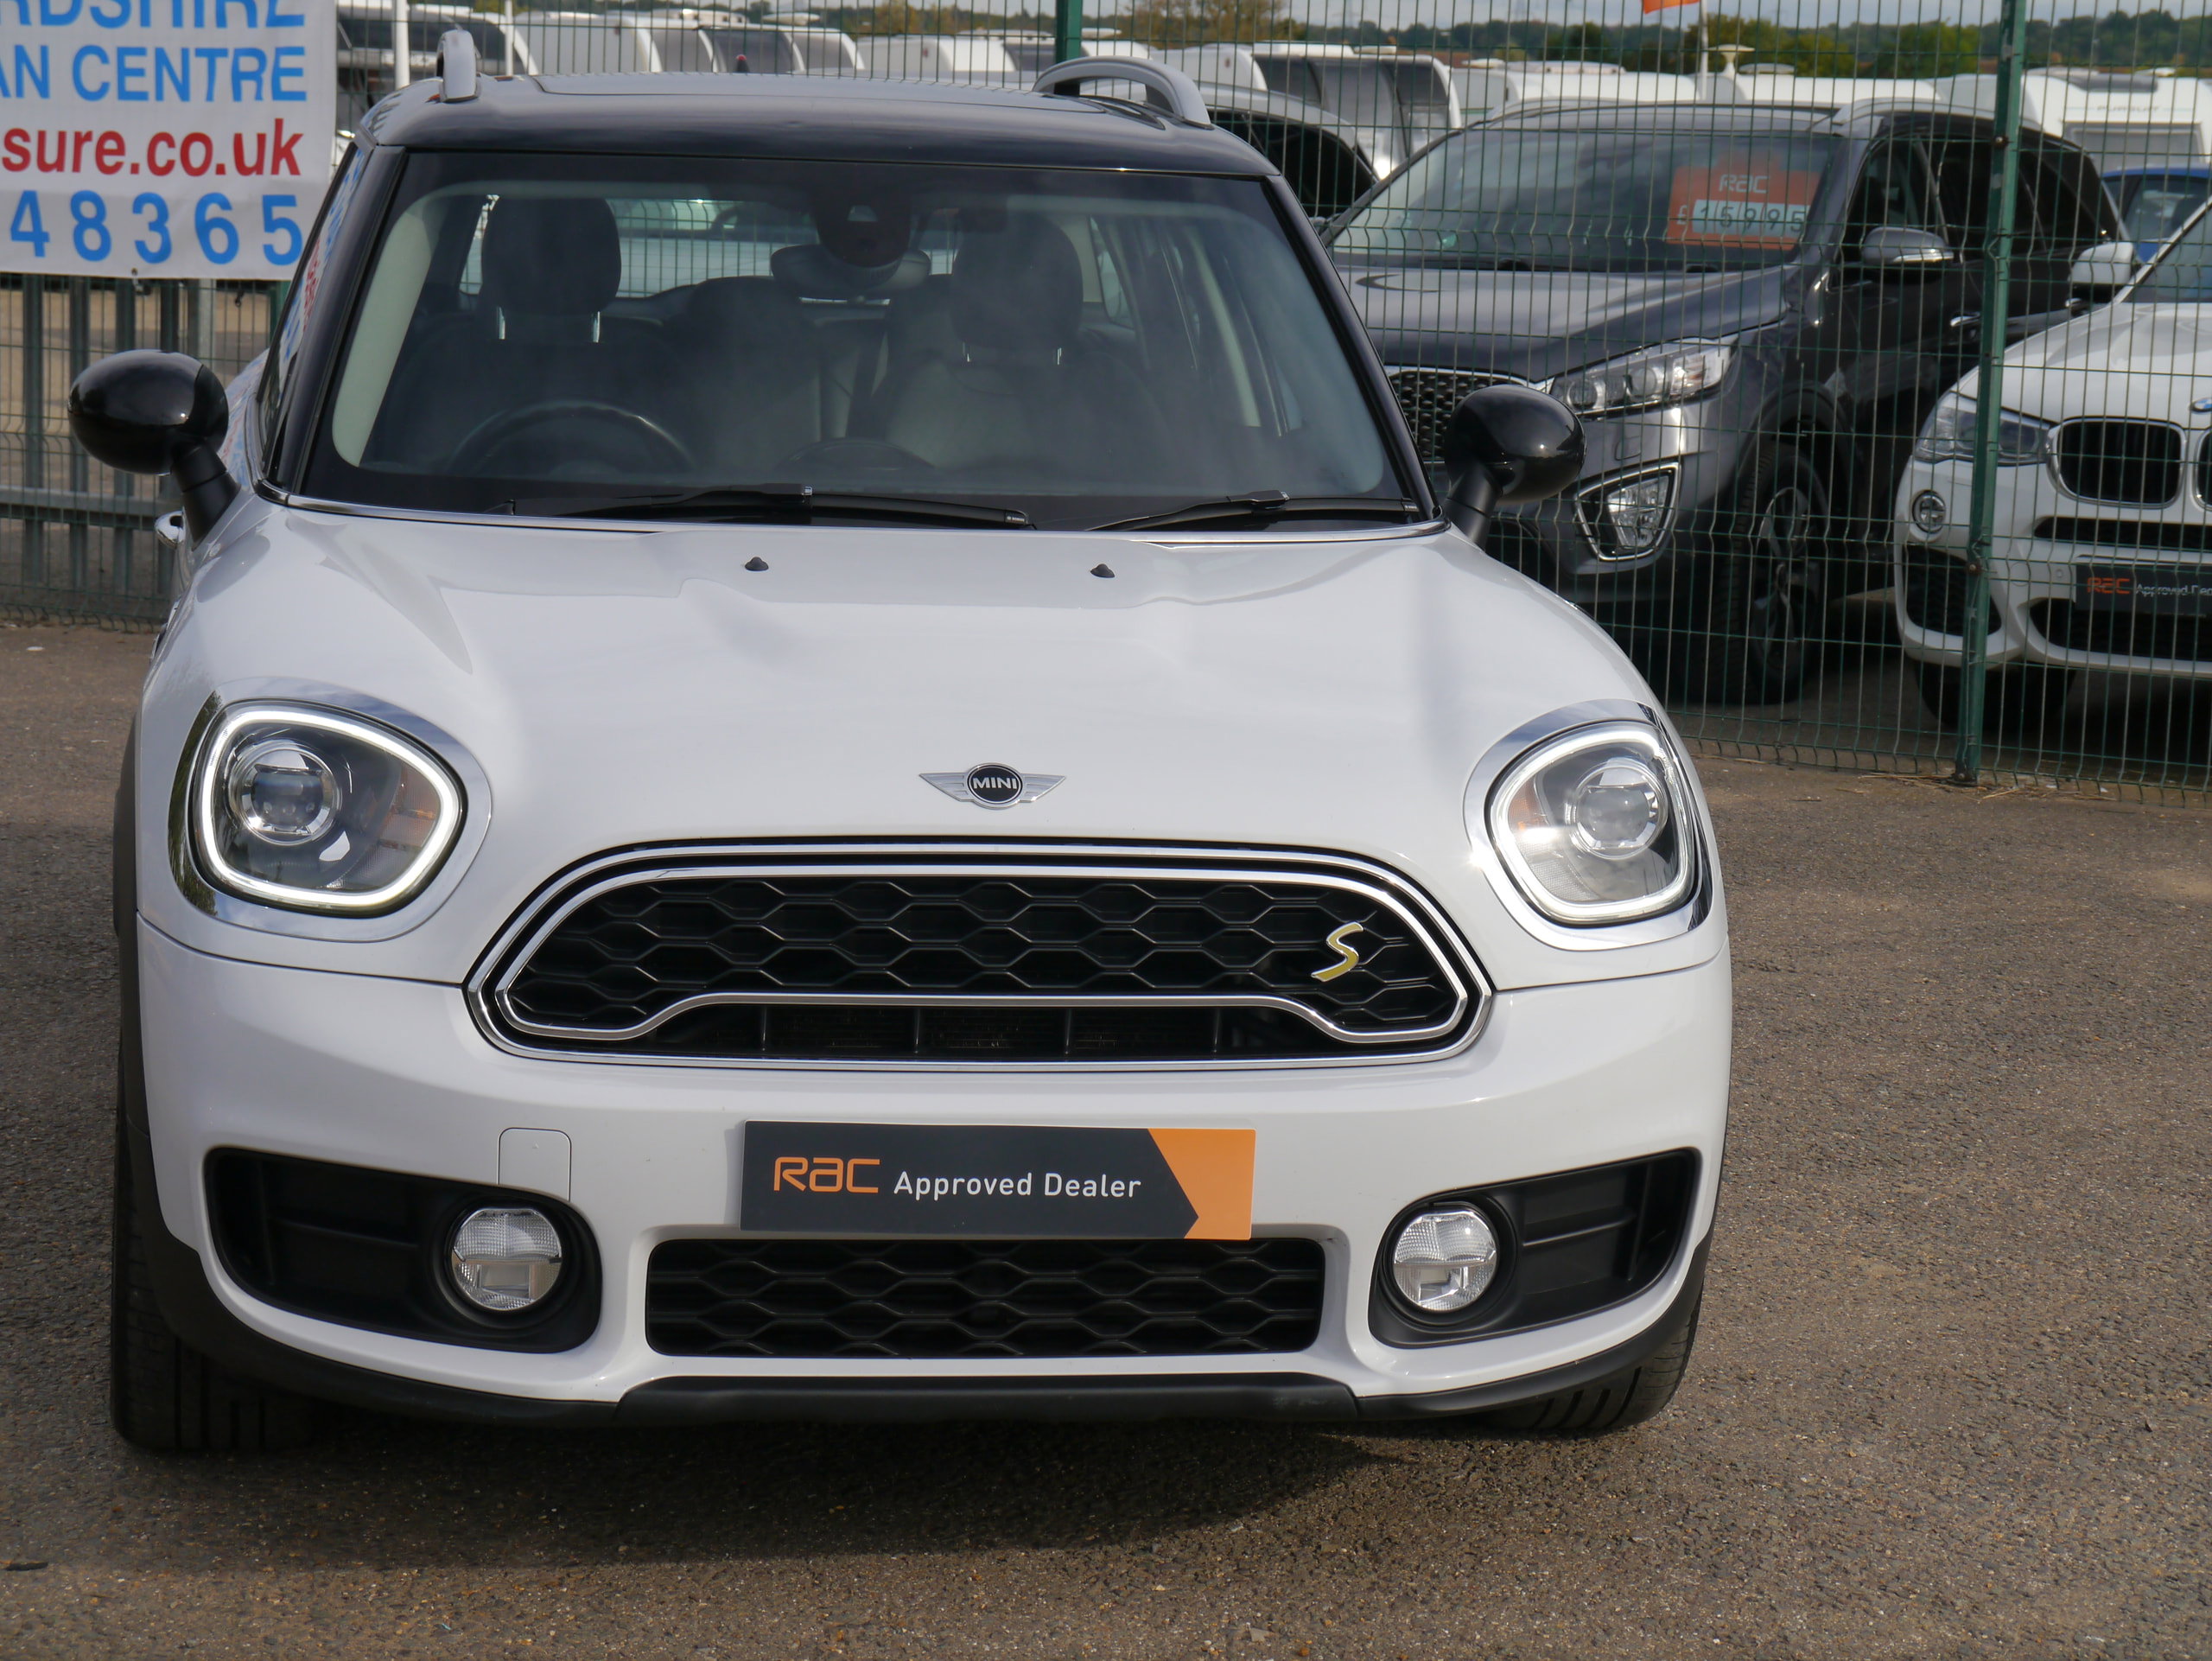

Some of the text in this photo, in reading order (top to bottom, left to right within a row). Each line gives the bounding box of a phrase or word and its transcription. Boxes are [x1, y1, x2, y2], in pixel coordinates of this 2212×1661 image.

[72, 45, 308, 102] CENTRE
[2, 118, 305, 176] sure.co.uk
[972, 777, 1018, 790] MINI
[1311, 921, 1364, 982] S
[893, 1171, 1033, 1201] Approved
[1044, 1172, 1141, 1198] Dealer
